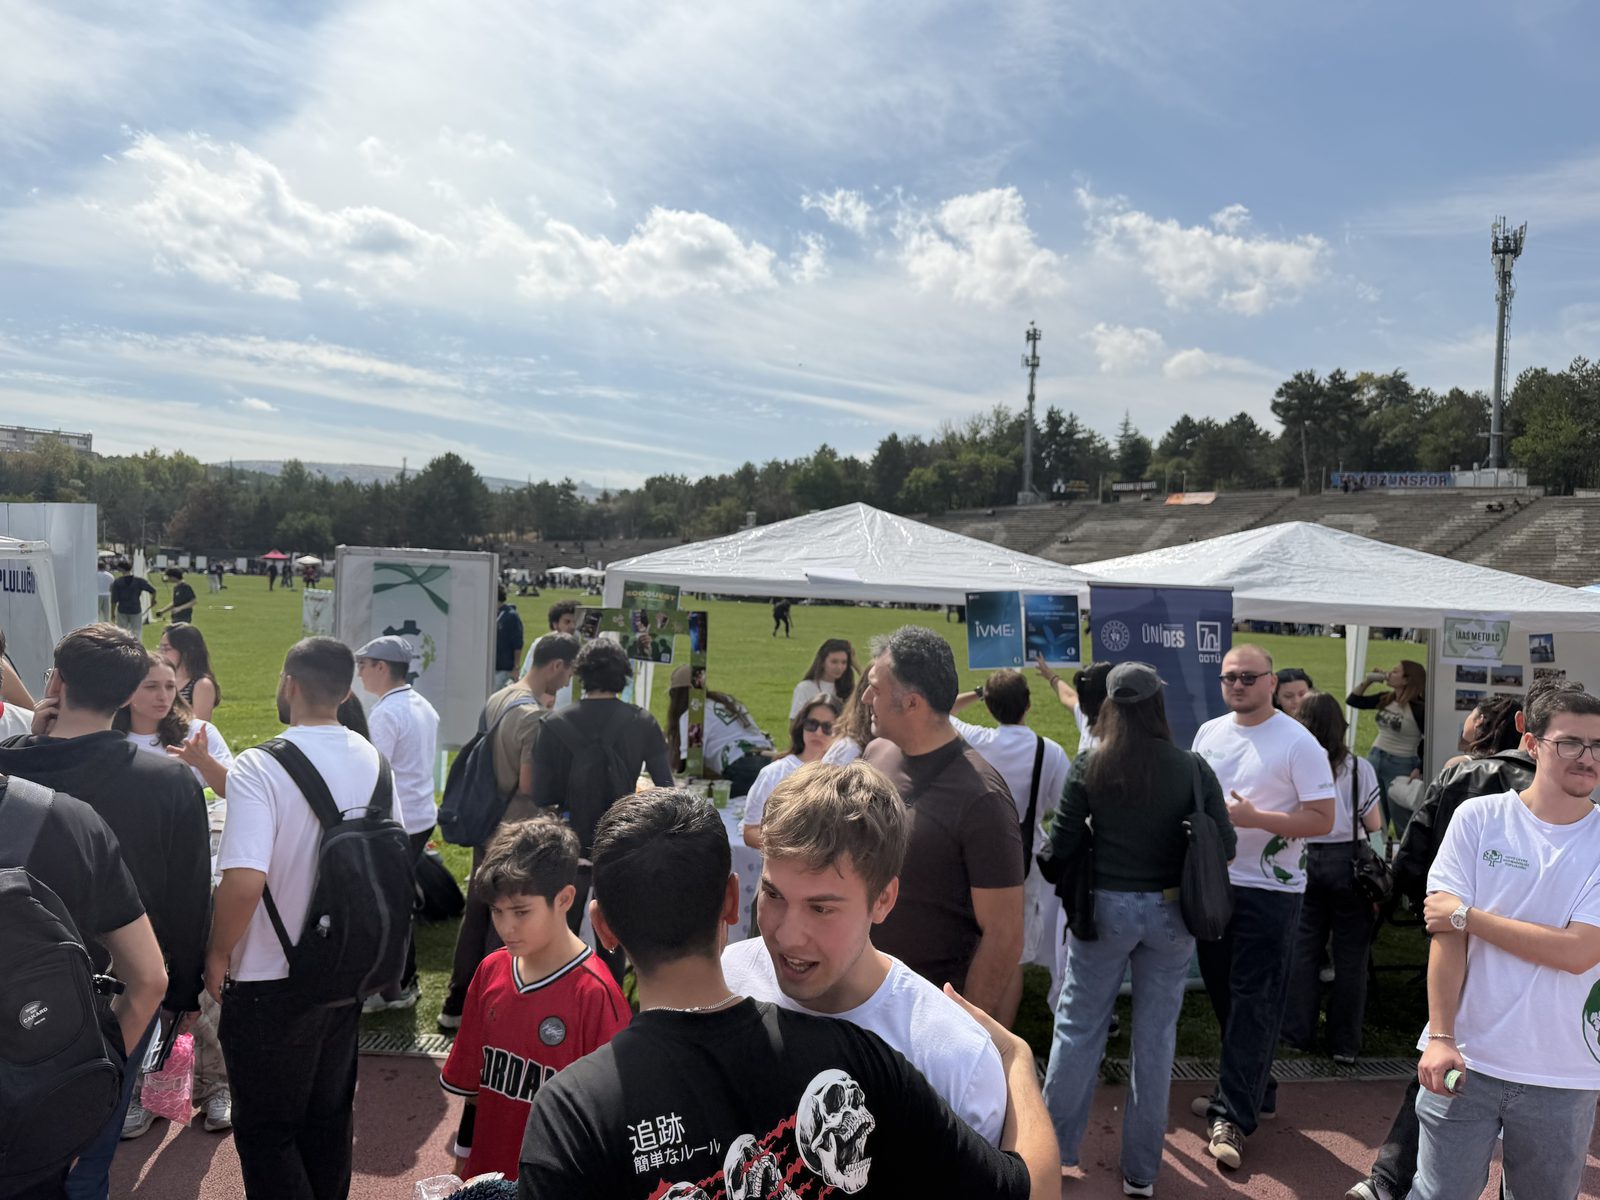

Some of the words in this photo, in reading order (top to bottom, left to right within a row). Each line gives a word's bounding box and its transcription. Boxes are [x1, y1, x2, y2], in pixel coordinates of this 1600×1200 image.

[1471, 631, 1490, 642] METU
[1491, 633, 1500, 642] LC
[627, 1112, 685, 1155] 追跡
[633, 1138, 721, 1174] 簡単なルール
